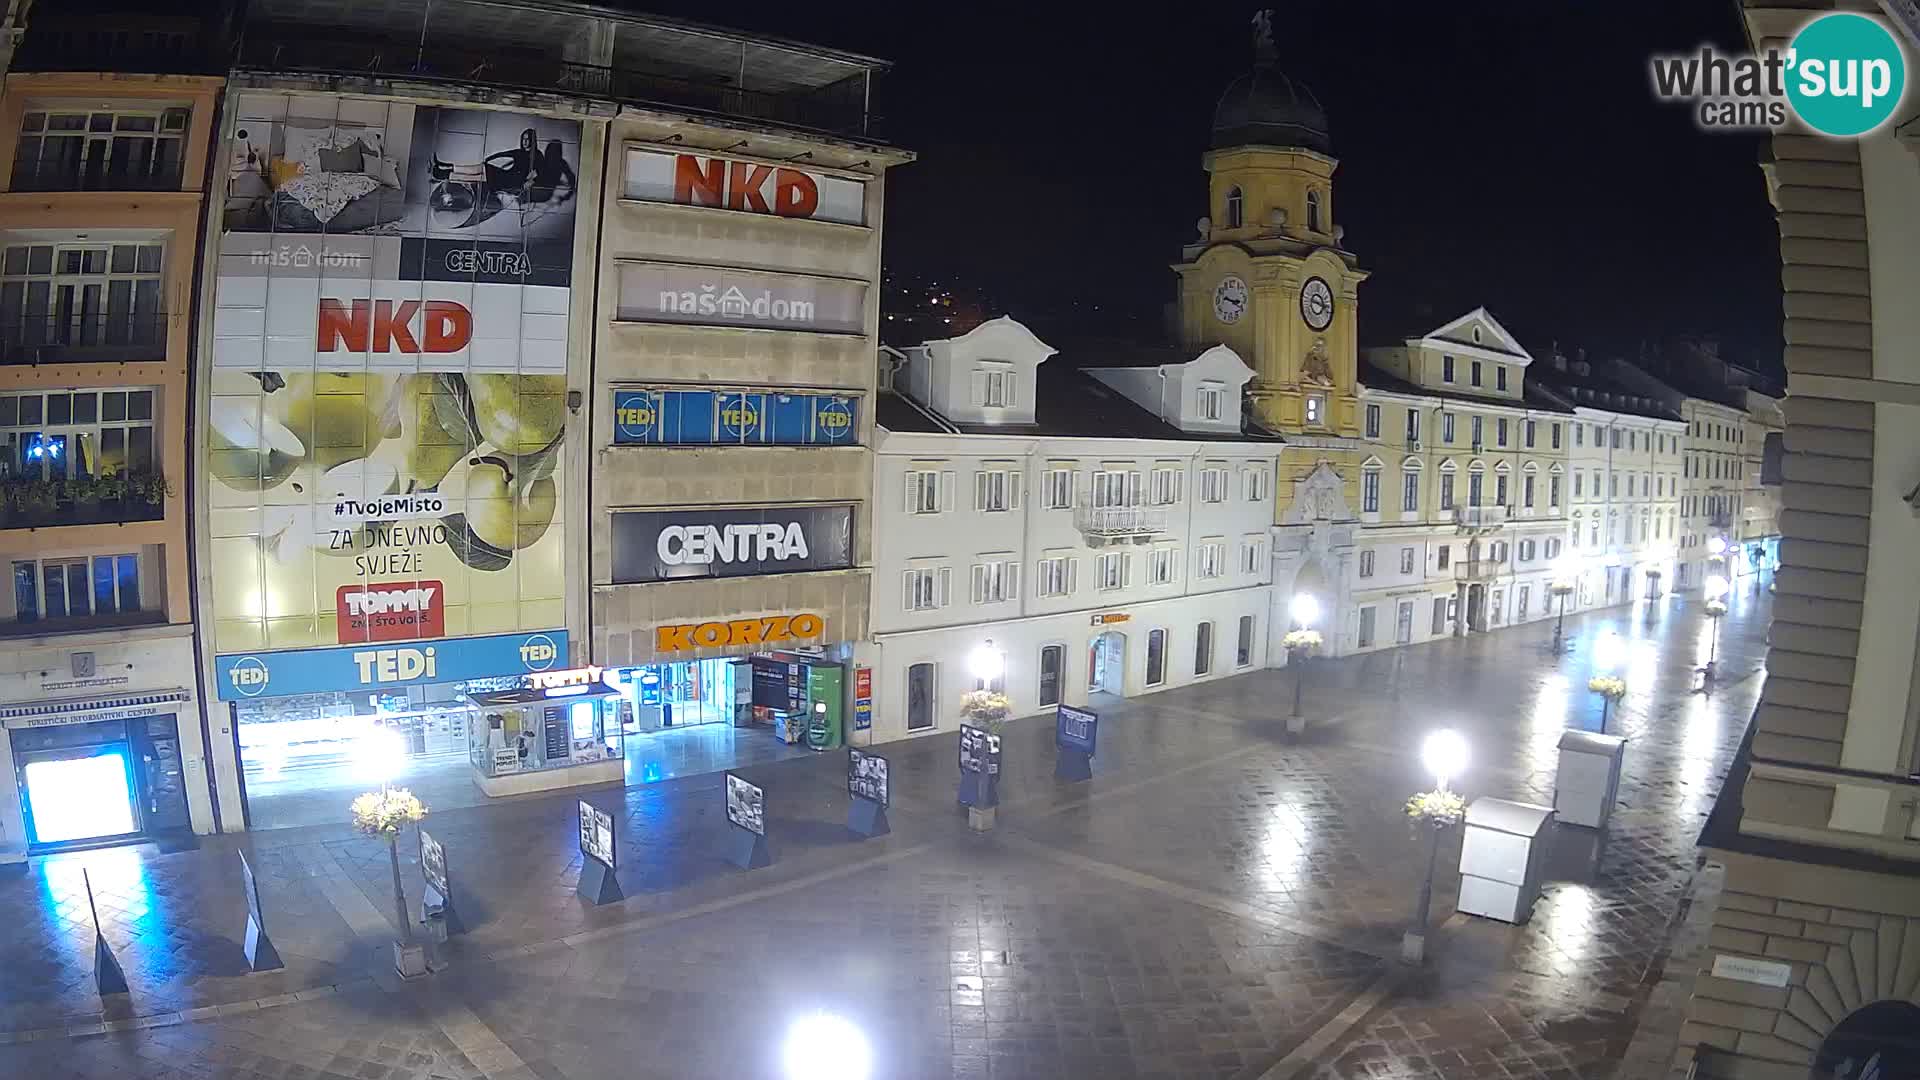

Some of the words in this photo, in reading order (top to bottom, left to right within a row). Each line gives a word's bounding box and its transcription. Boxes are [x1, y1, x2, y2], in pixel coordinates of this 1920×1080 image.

[674, 154, 819, 218] NKD
[250, 246, 290, 267] naš
[315, 248, 361, 269] dom
[445, 249, 532, 275] CENTRA
[660, 284, 717, 316] naš
[752, 289, 815, 322] dom
[316, 297, 474, 354] NKD
[335, 497, 443, 517] #TvojeMisto
[329, 530, 354, 550] ZA
[365, 525, 448, 548] DNEVNO
[657, 522, 809, 566] CENTRA
[355, 548, 423, 576] SVJEŽE
[345, 588, 436, 616] TOMMY
[656, 614, 824, 652] KORZO
[229, 667, 270, 686] TEDi
[353, 646, 437, 684] TEDi
